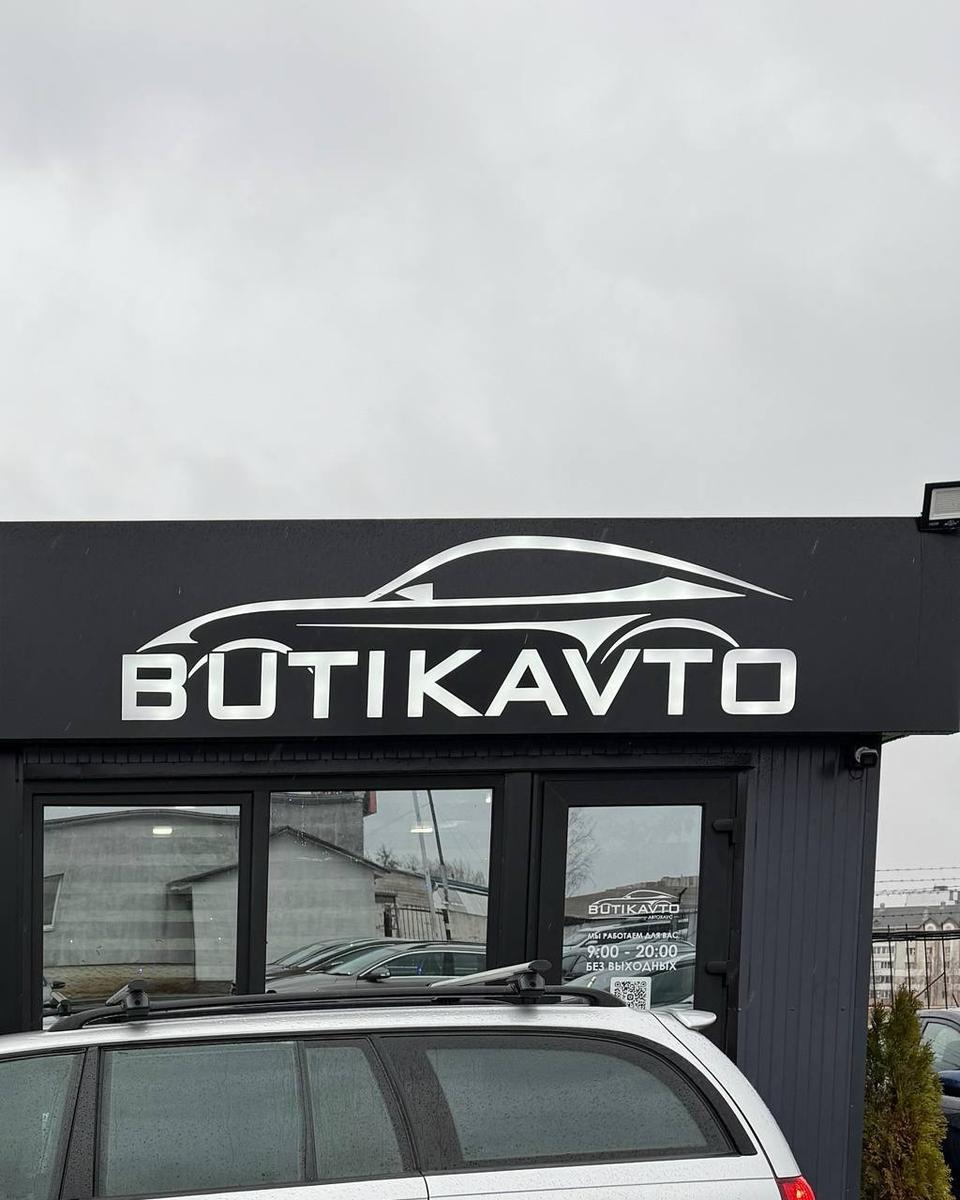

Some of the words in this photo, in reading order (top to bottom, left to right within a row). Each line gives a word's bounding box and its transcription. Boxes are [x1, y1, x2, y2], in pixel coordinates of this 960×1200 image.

[122, 648, 796, 720] BUTIKAVTO
[588, 904, 679, 914] BUTIKAVTO
[644, 932, 662, 940] ДЛЯ
[663, 931, 678, 939] ВАС
[587, 945, 619, 958] 9:00
[635, 944, 678, 958] 20:00
[586, 961, 605, 972] БЕЗ
[608, 961, 677, 972] ВЫХОДНЫХ
